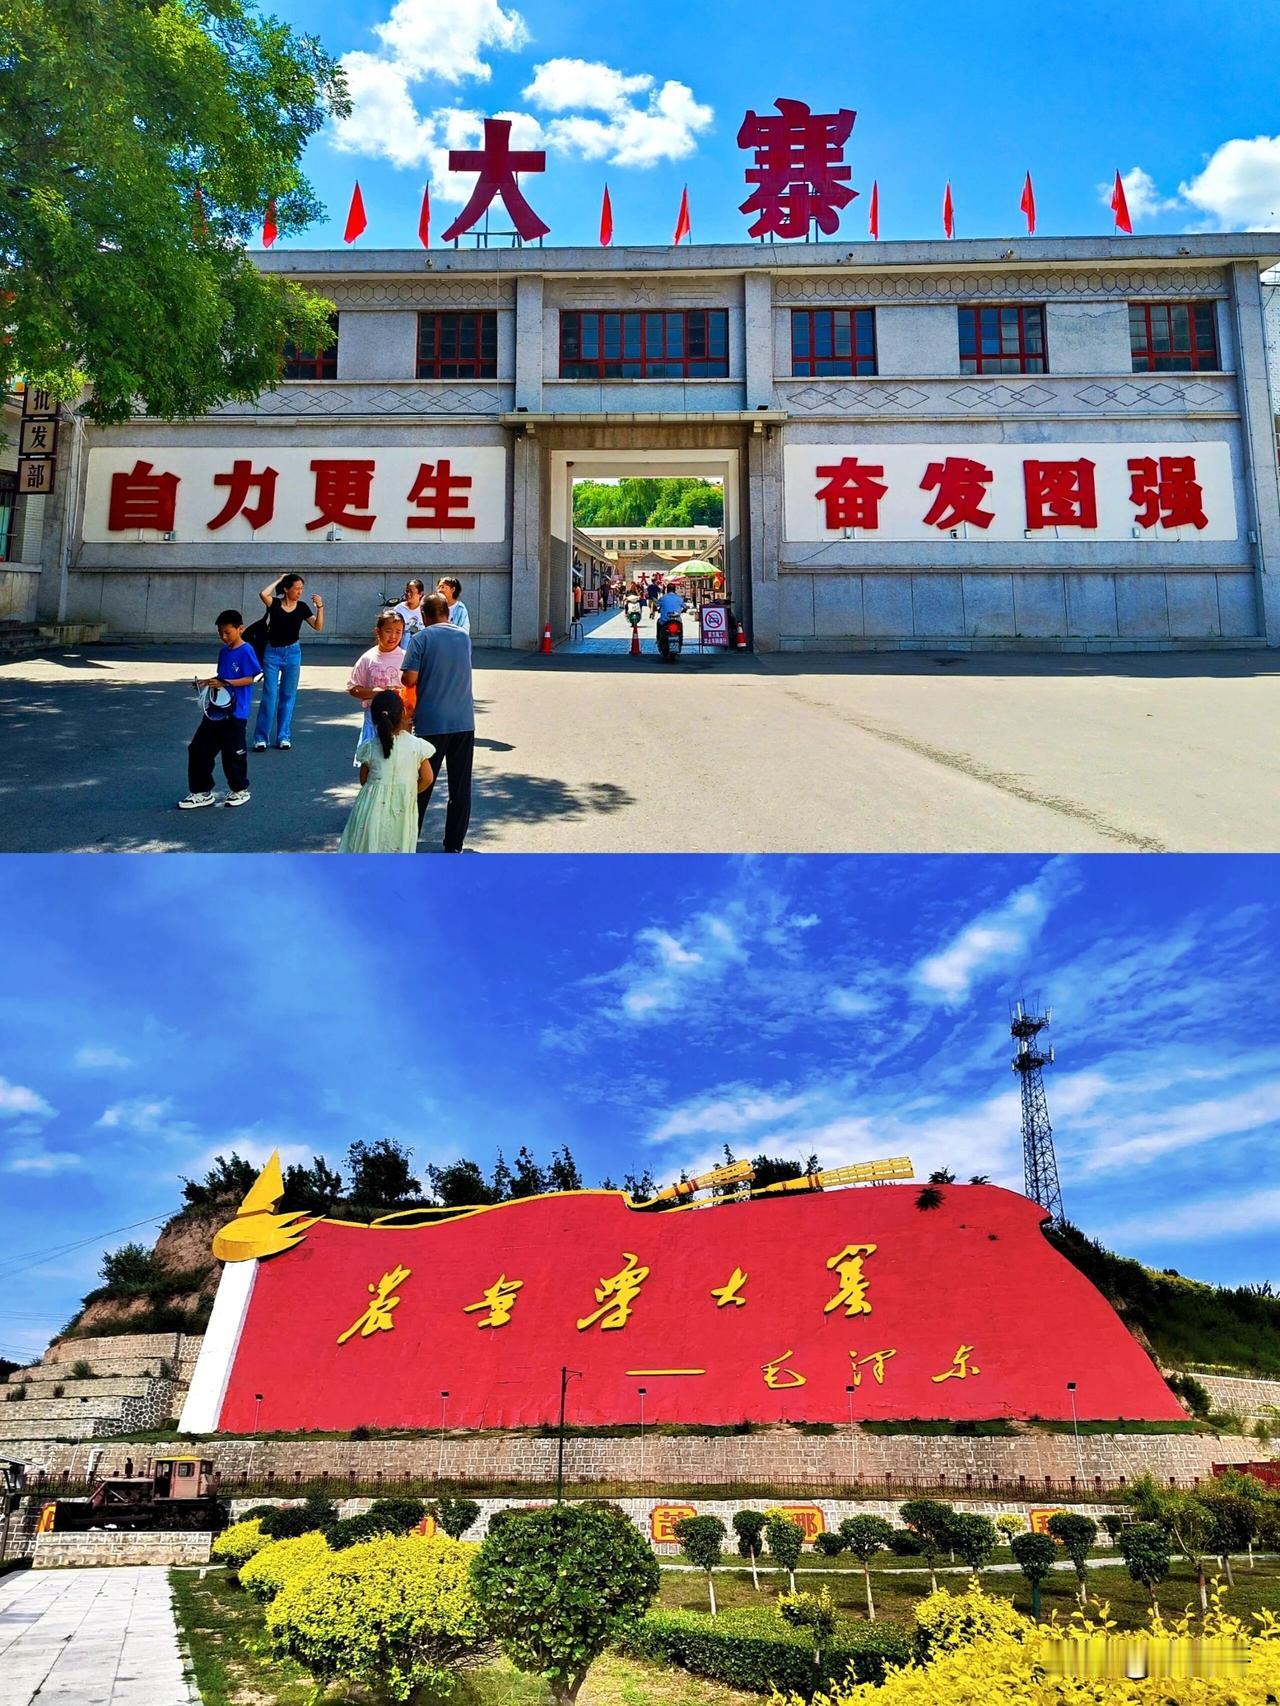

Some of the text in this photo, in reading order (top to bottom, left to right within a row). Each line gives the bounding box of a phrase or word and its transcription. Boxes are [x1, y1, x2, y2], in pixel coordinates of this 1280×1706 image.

[441, 97, 860, 243] 大寨
[27, 389, 50, 488] 批发部
[108, 459, 476, 532] 自力更生
[815, 456, 1209, 530] 奋发图强
